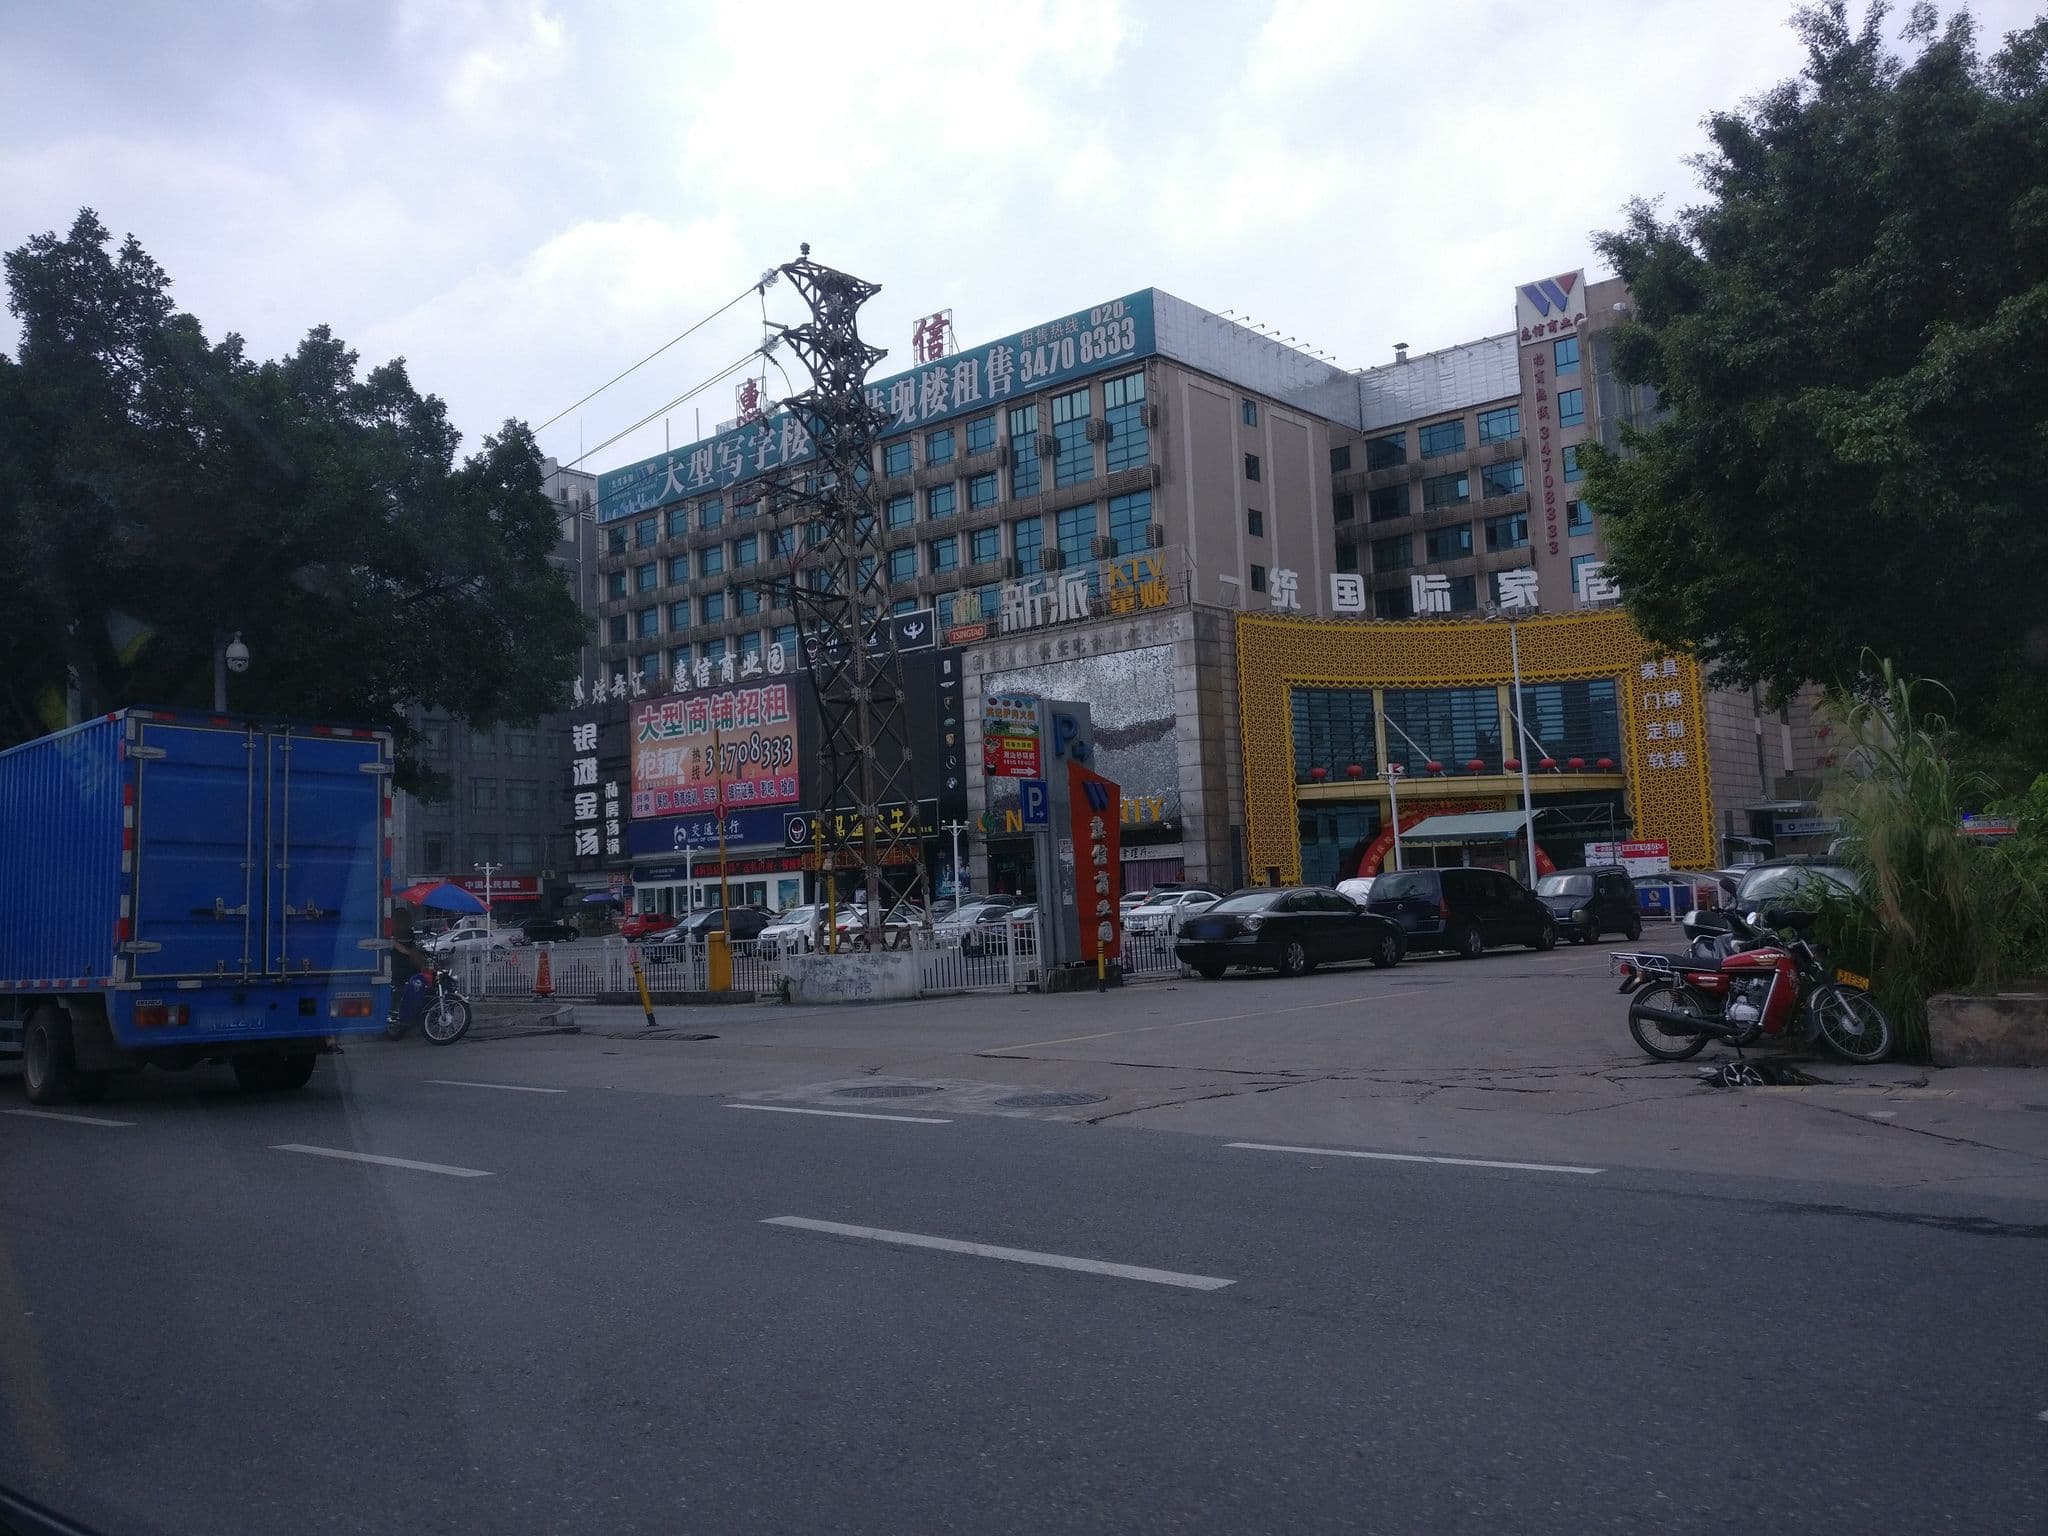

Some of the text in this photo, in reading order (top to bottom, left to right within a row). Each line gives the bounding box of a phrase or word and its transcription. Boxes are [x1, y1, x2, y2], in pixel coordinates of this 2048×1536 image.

[913, 303, 950, 364] 信
[1020, 317, 1135, 382] 3470 8333
[1109, 552, 1166, 586] KTV
[1001, 569, 1090, 632] 新派
[951, 627, 984, 640] TSINGTAO
[672, 642, 785, 693] 惠信商业园
[1641, 659, 1678, 680] 家具
[637, 684, 790, 744] 大型商铺招租
[1053, 714, 1078, 756] P
[1647, 720, 1684, 740] 定制
[572, 722, 600, 856] 银滩金汤
[1028, 787, 1042, 818] P
